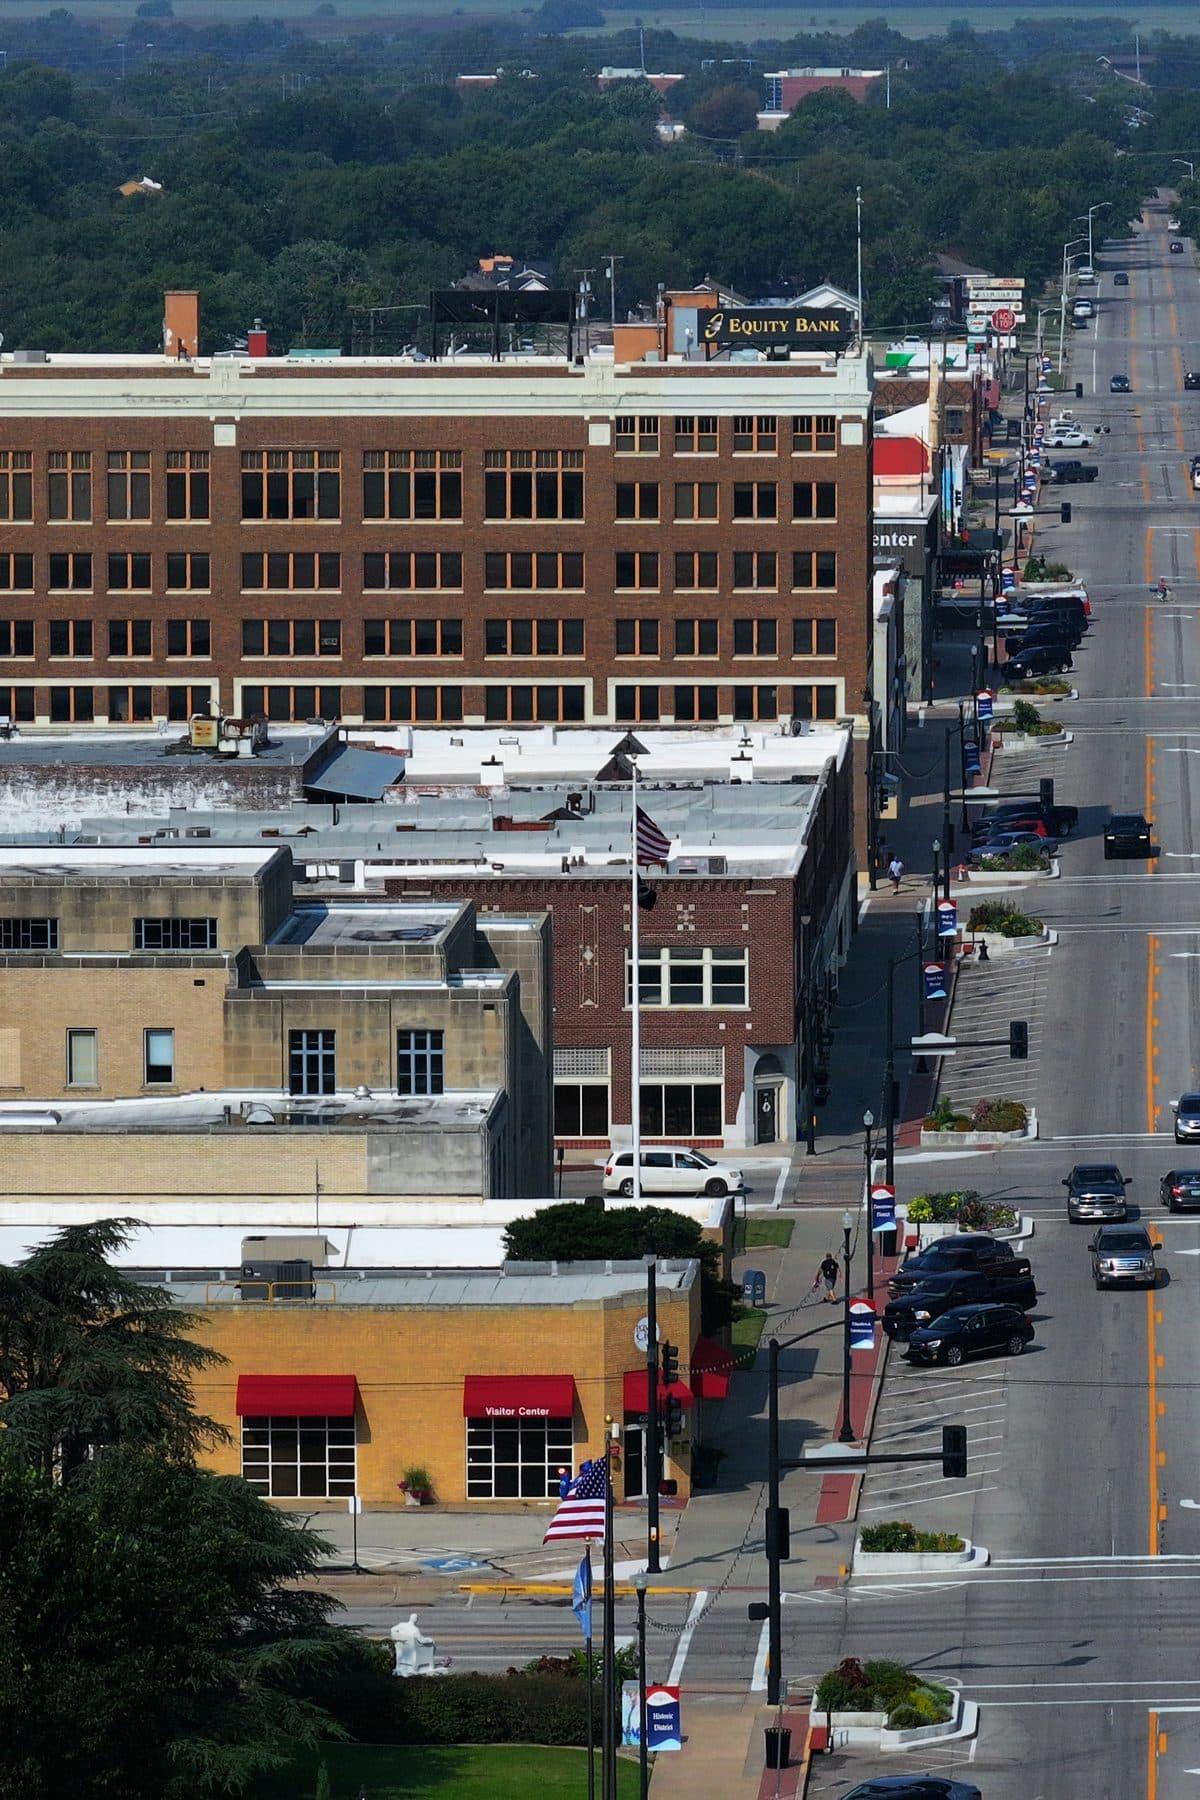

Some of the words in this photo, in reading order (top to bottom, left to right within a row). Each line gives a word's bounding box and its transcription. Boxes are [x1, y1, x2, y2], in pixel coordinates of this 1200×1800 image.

[729, 318, 789, 335] EQUITY
[795, 318, 840, 332] BANK
[873, 531, 917, 546] enter
[485, 1407, 515, 1416] Visitor
[518, 1407, 550, 1416] Center
[653, 1712, 674, 1720] Historic
